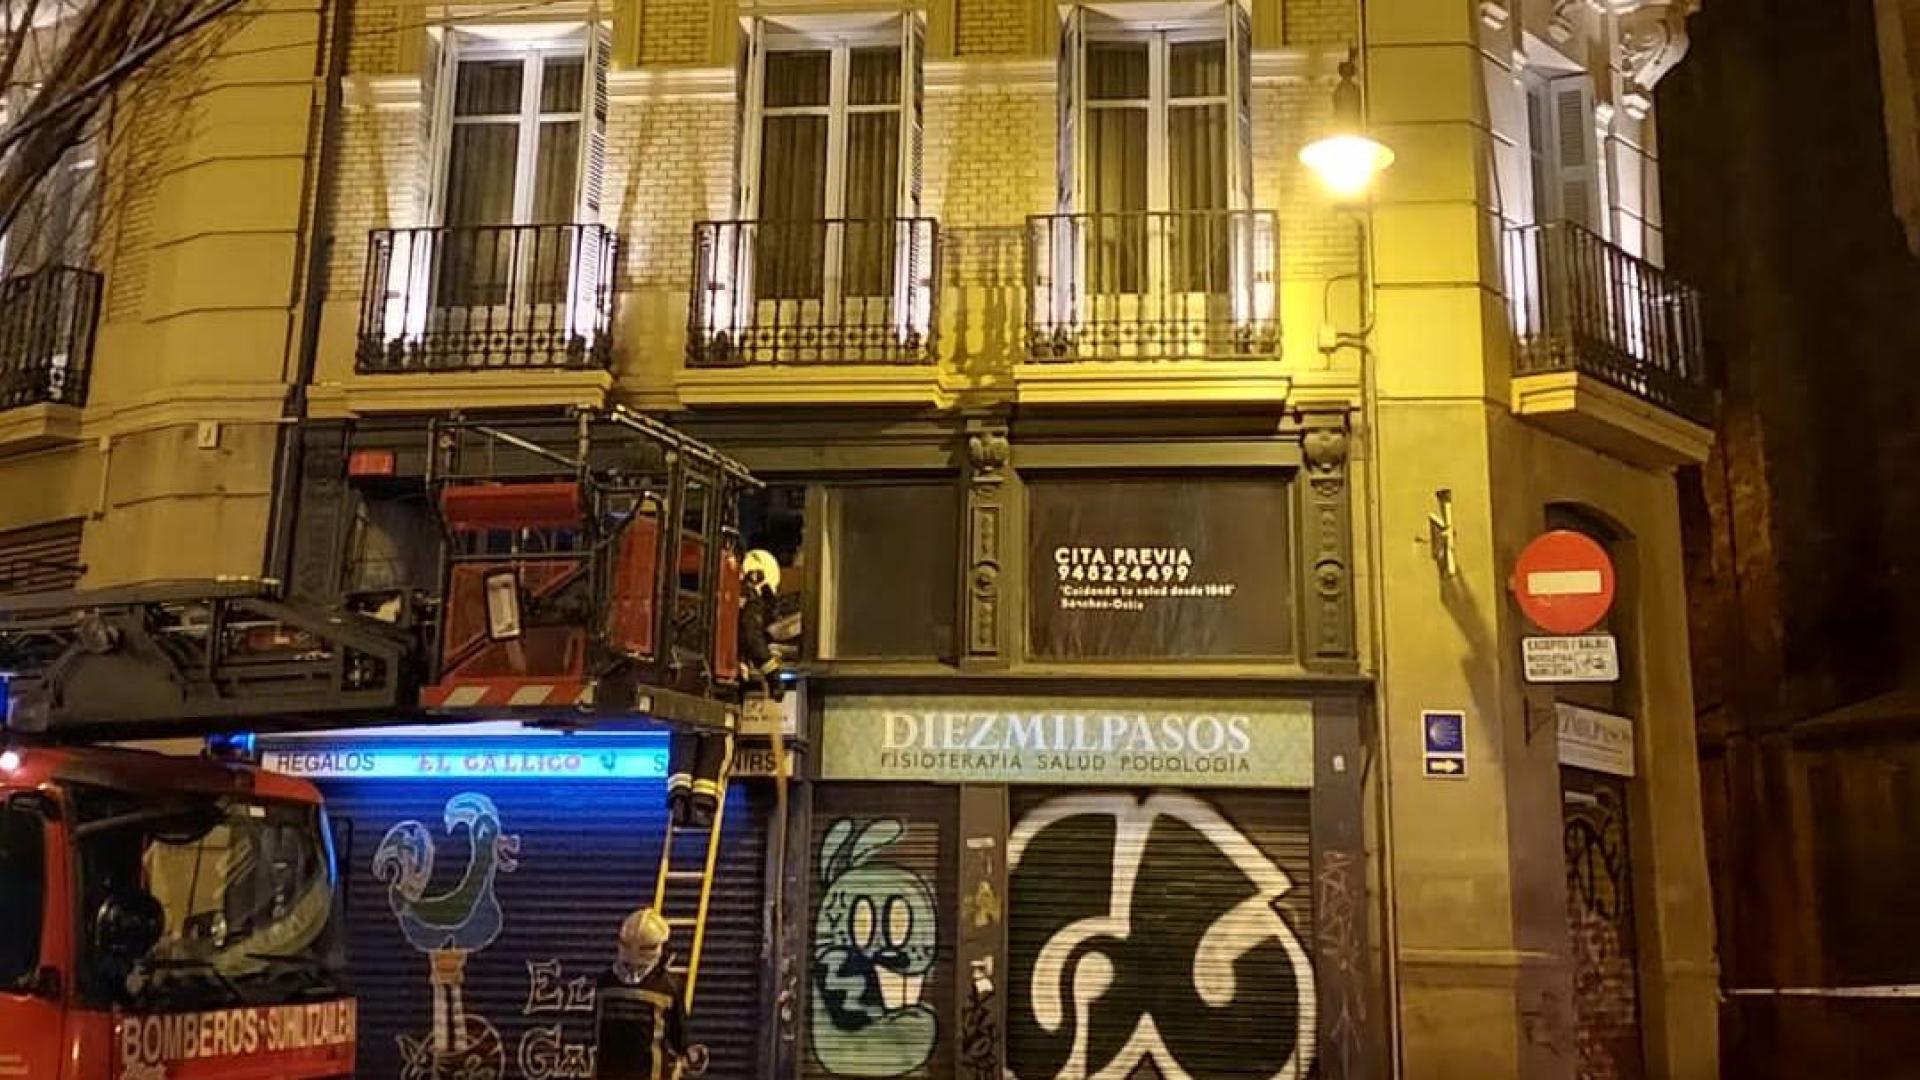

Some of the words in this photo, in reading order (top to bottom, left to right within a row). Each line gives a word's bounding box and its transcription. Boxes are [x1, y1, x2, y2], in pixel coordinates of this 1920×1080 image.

[1055, 547, 1106, 565] CITA
[1114, 547, 1192, 565] PREVIA
[1057, 565, 1189, 582] 948224499
[1137, 585, 1167, 596] salud
[1170, 584, 1203, 596] desde
[880, 709, 1251, 754] DIEZMILPASOS
[277, 753, 375, 772] REGALOS
[880, 752, 1022, 770] FISIOTERAPIA
[1037, 755, 1106, 771] SALUD
[121, 1009, 257, 1064] BOMBEROS
